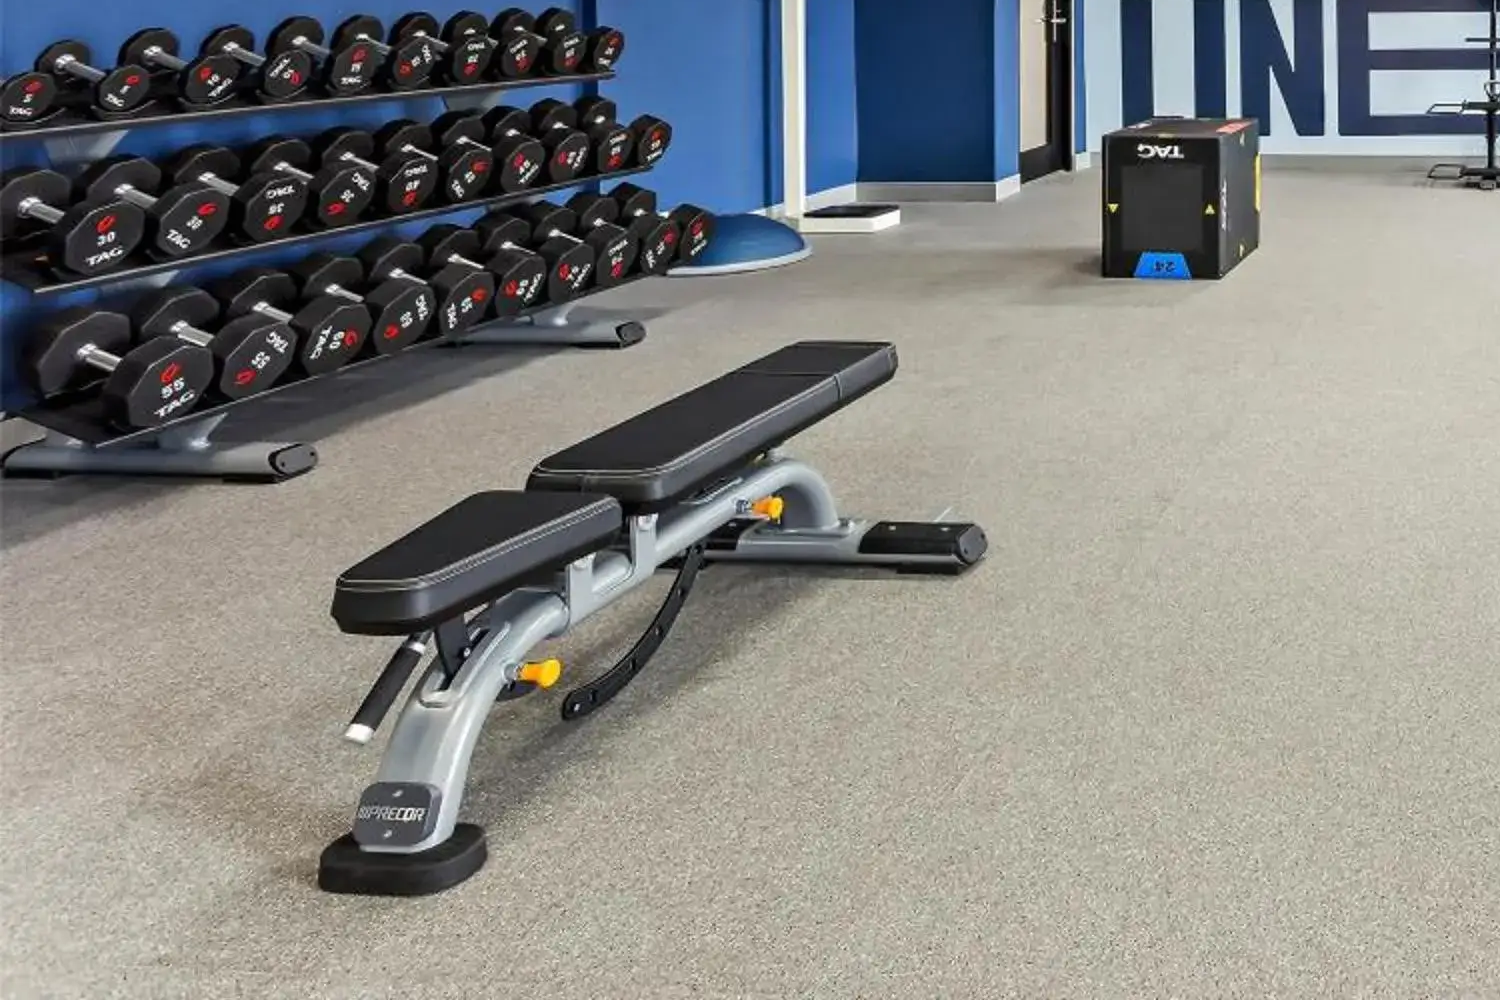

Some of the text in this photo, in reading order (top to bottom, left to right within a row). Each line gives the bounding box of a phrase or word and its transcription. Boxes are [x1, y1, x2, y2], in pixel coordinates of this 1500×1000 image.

[1136, 143, 1185, 159] TAG
[97, 231, 116, 247] 30
[265, 330, 289, 354] TAG
[309, 325, 333, 360] TAG
[328, 331, 345, 350] 60
[251, 351, 271, 370] 55
[161, 377, 185, 399] 55
[152, 389, 195, 419] TAG
[369, 805, 426, 821] PRECOR
